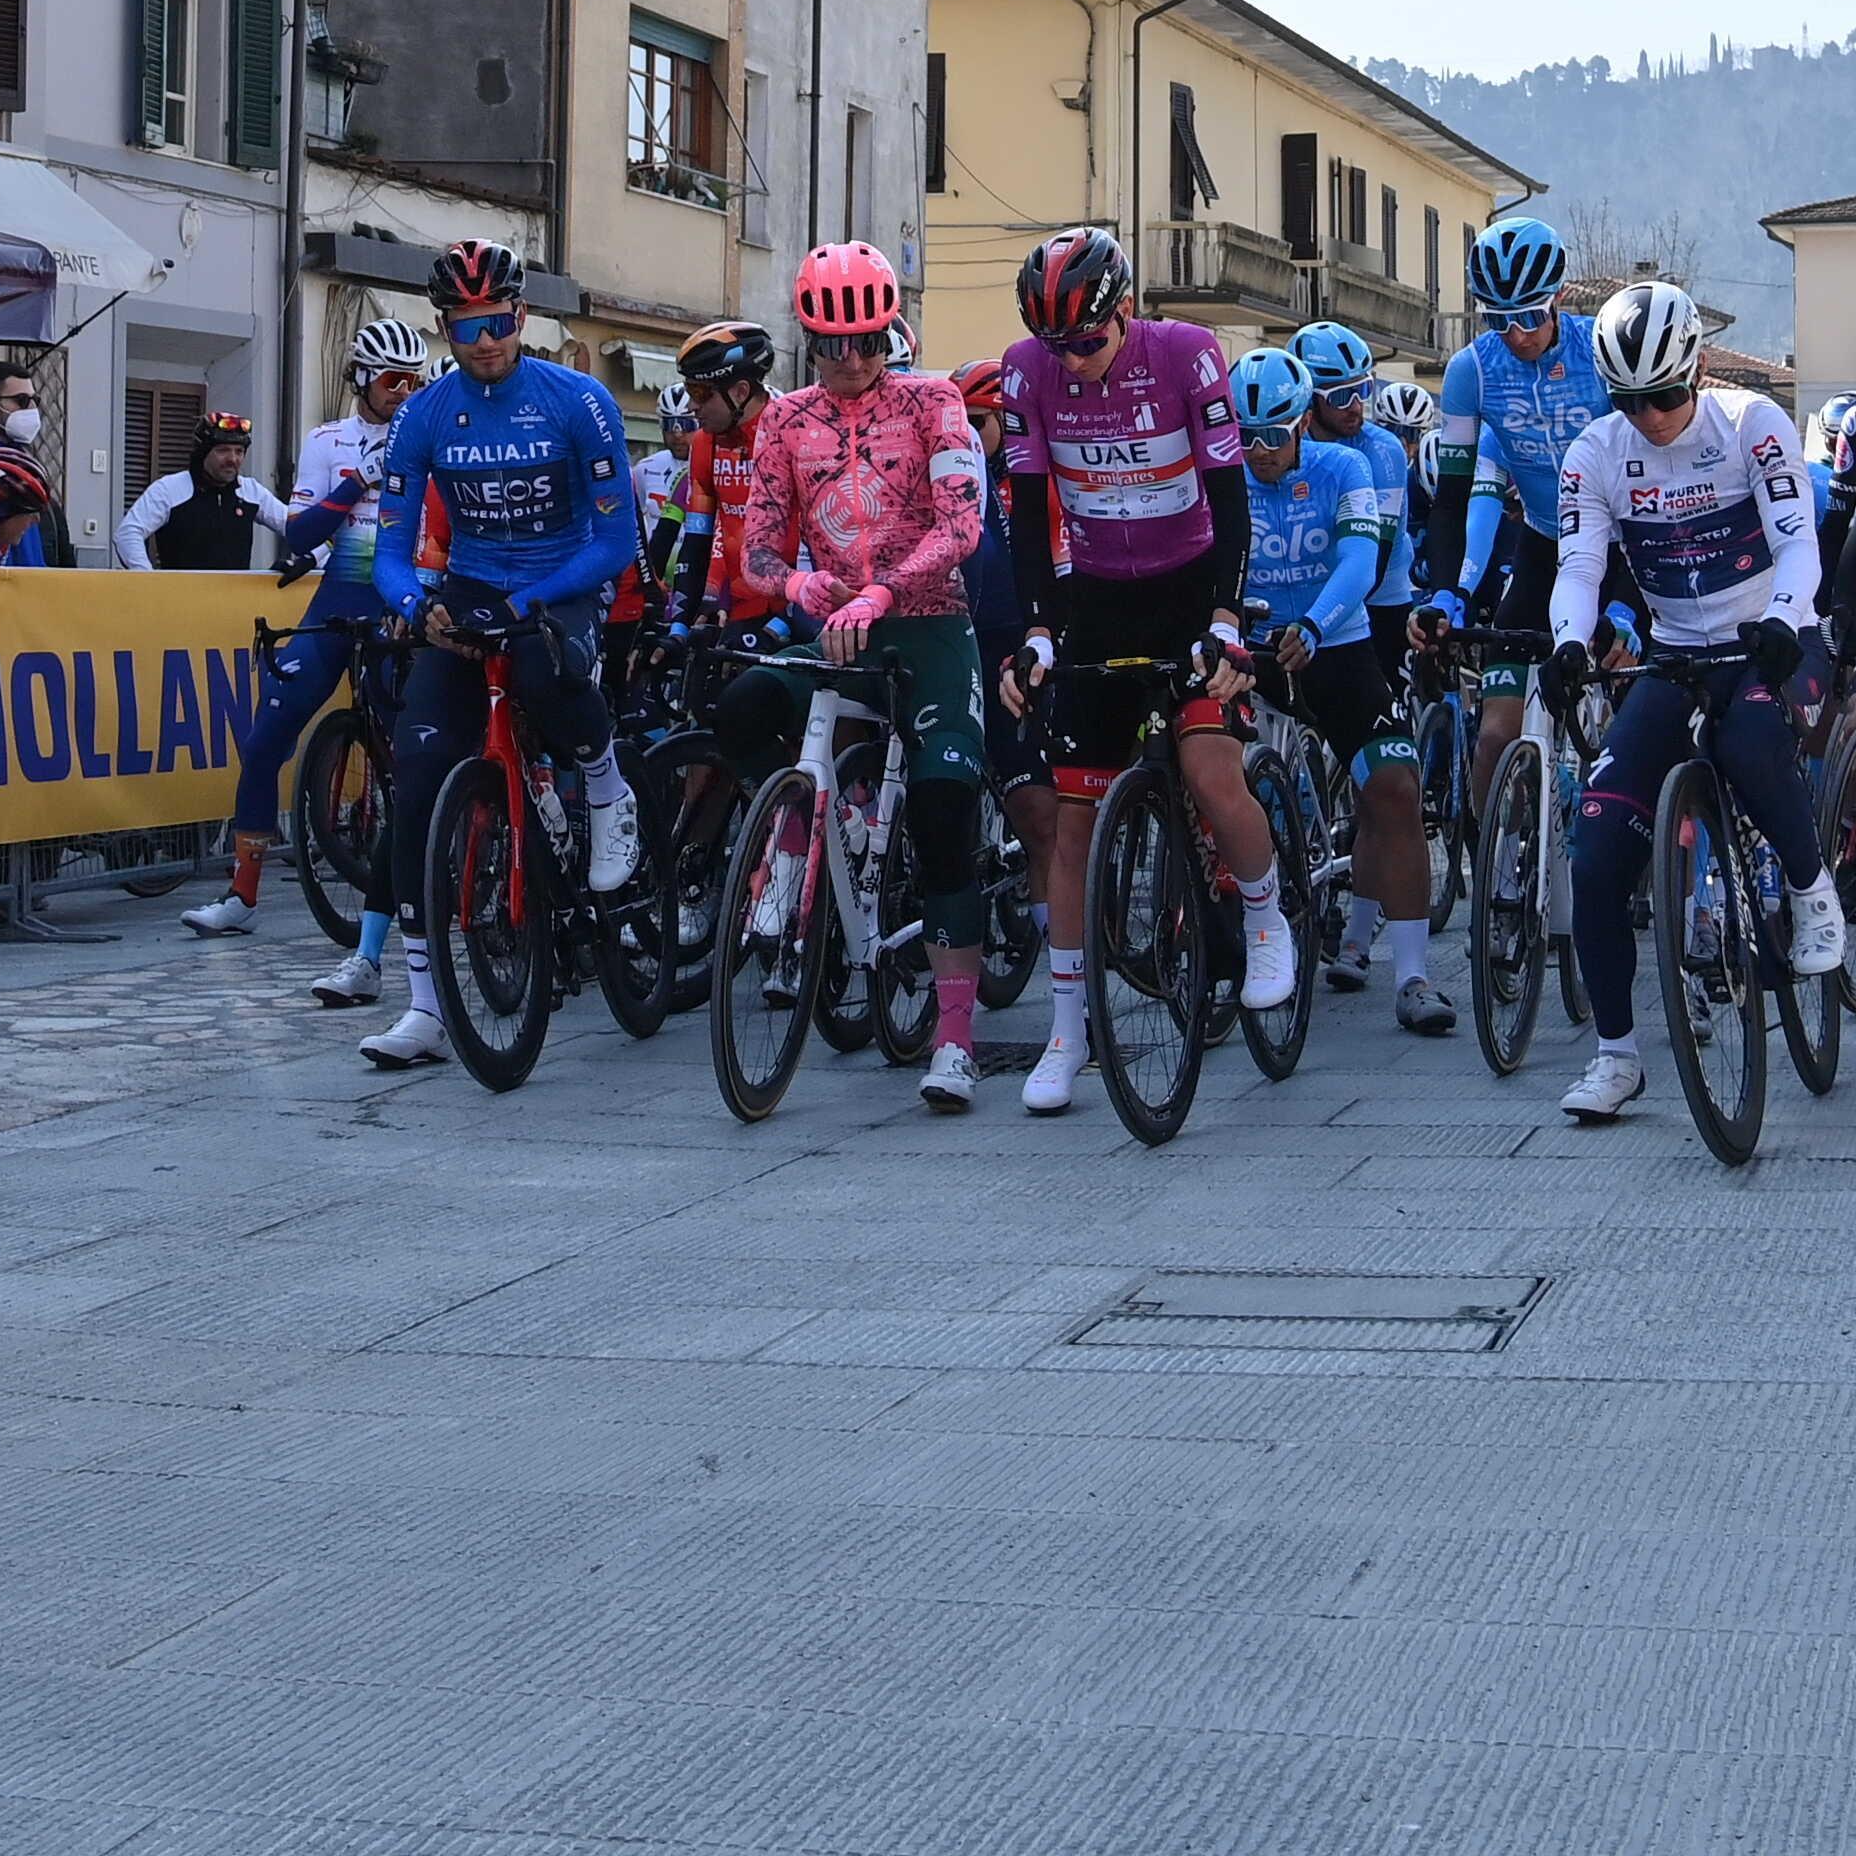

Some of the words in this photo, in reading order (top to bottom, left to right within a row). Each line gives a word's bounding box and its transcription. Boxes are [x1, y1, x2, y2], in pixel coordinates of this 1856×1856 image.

[694, 363, 736, 380] RUDY
[581, 391, 614, 444] ITALIA.IT
[1055, 411, 1079, 425] Italy
[446, 440, 553, 464] ITALIA.IT
[1079, 441, 1153, 467] UAE
[451, 475, 553, 505] INEOS
[1087, 470, 1157, 486] Emirates
